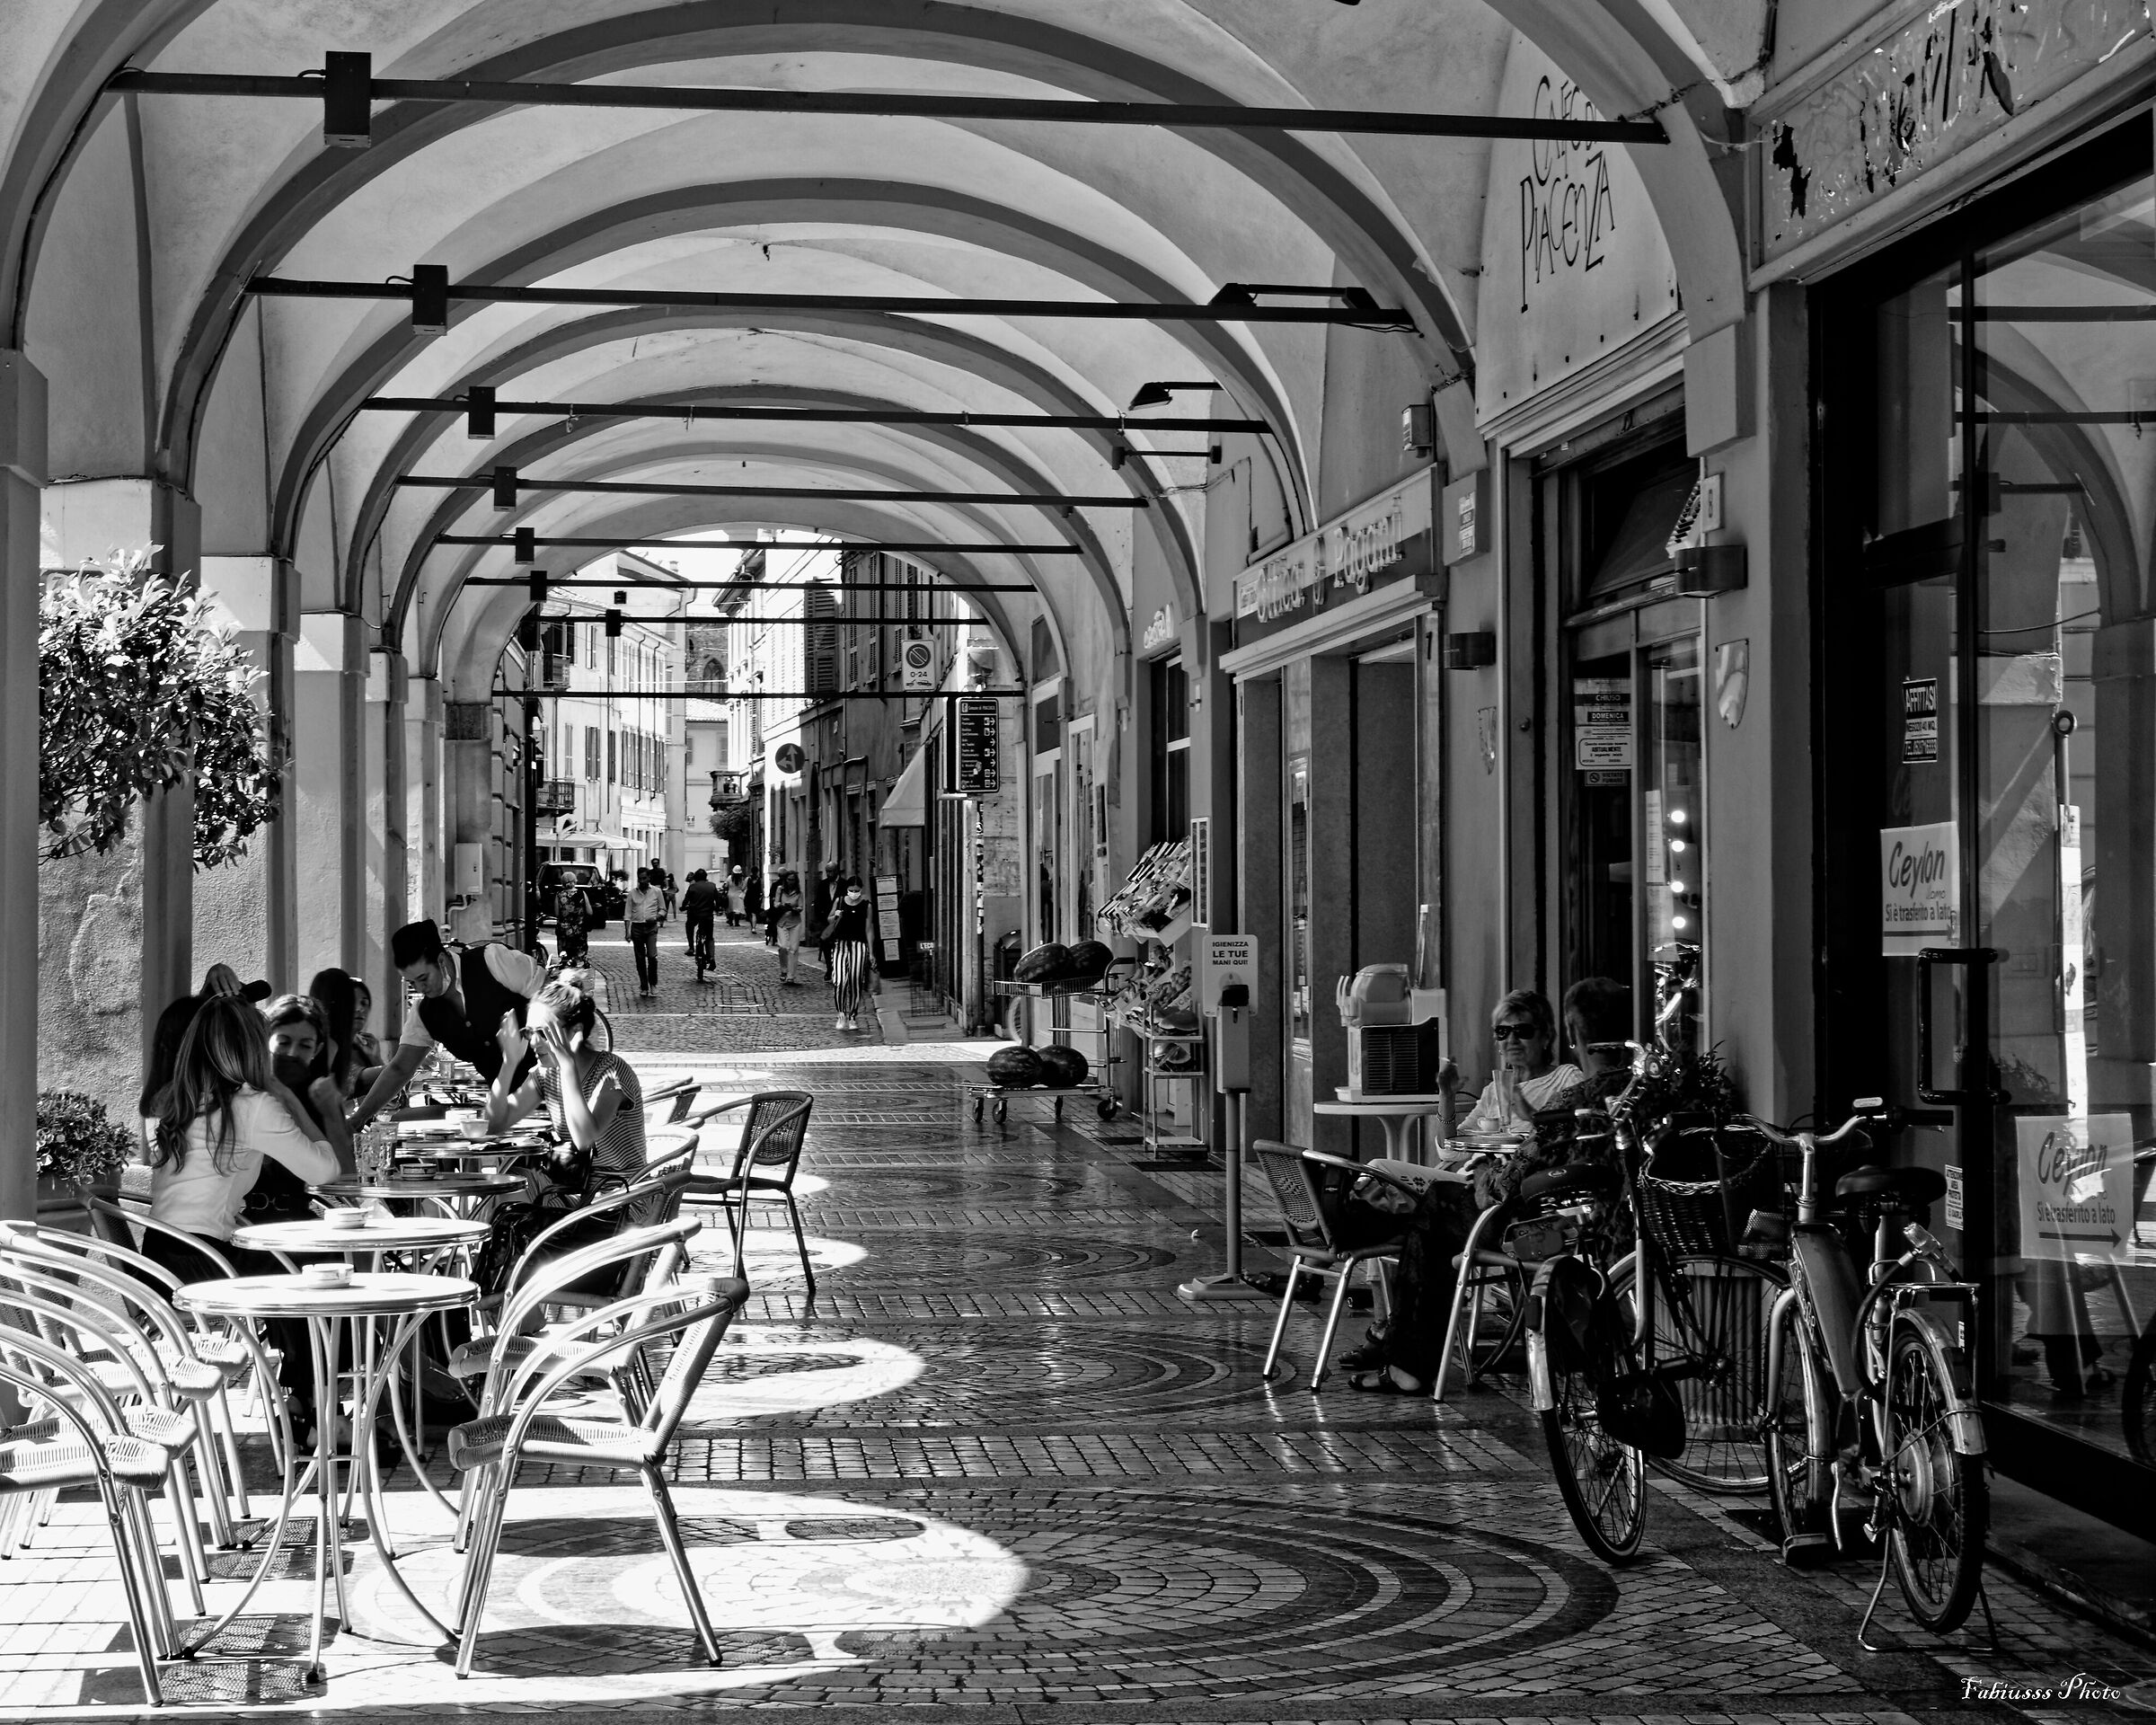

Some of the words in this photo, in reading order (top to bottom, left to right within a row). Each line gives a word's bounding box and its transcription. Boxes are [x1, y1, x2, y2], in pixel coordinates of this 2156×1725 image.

[1520, 150, 1615, 313] PIACENZA
[1905, 685, 1937, 712] AFFITTASI
[1889, 841, 1945, 898] Ceylon
[1899, 902, 1929, 922] trasferito
[1931, 906, 1935, 920] a
[2051, 1202, 2090, 1224] trasferito
[2092, 1208, 2097, 1224] a
[2099, 1202, 2116, 1224] lato
